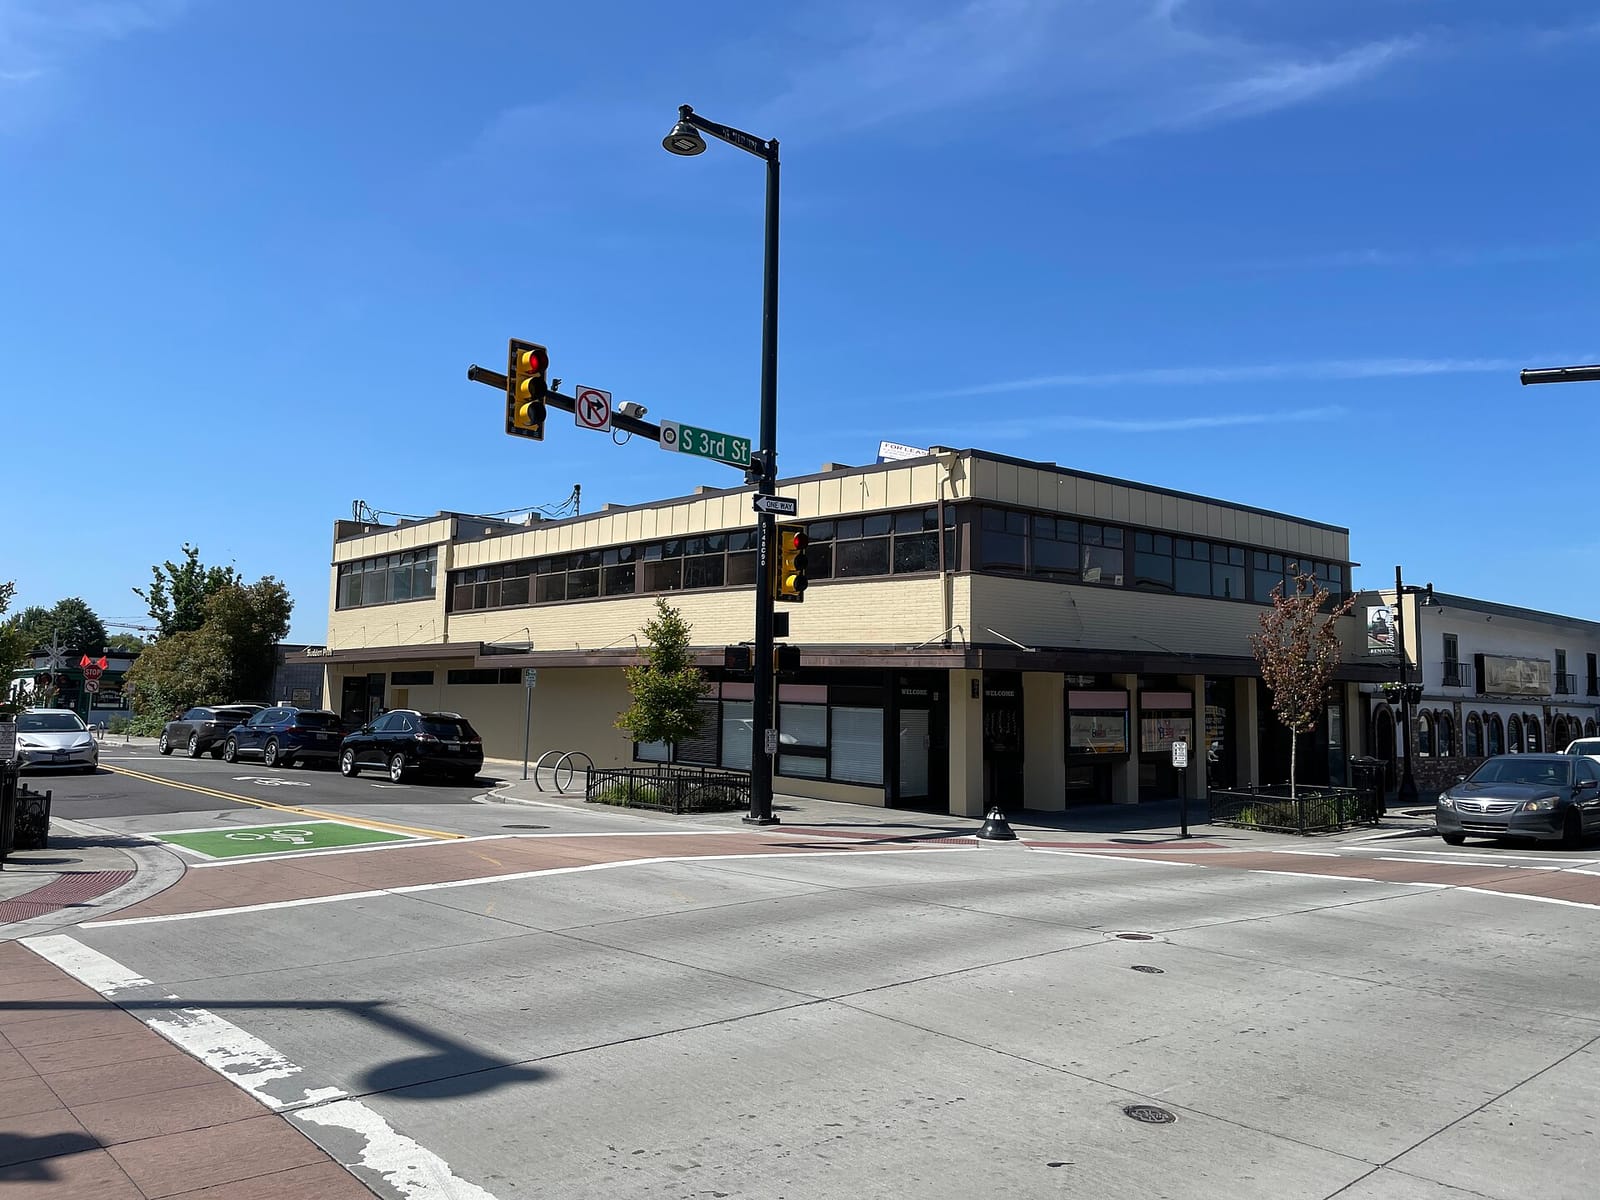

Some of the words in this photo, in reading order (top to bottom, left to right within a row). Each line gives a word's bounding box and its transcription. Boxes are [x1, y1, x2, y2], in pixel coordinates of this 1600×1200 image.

[682, 429, 693, 450] S
[699, 432, 725, 457] 3rd
[731, 439, 747, 462] St
[766, 500, 779, 510] ONE
[780, 501, 793, 511] WAY
[85, 668, 101, 676] STOP
[901, 688, 928, 696] WELCOME
